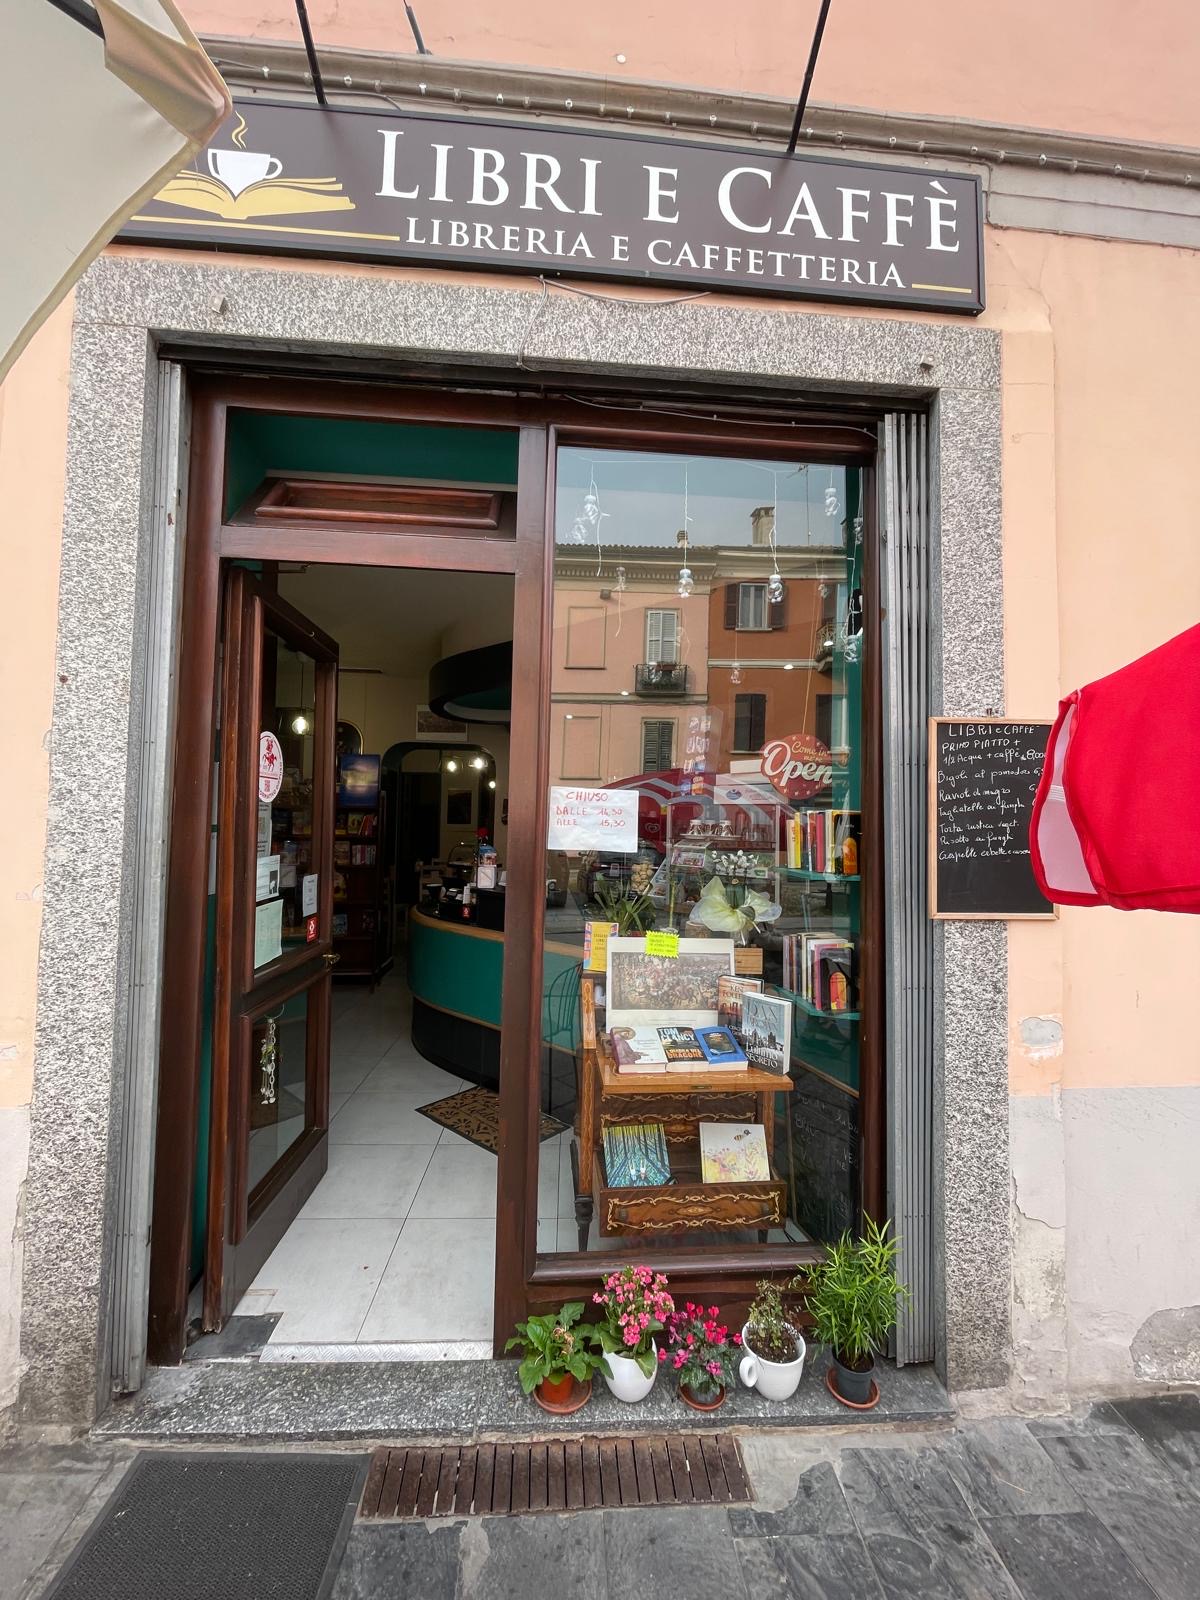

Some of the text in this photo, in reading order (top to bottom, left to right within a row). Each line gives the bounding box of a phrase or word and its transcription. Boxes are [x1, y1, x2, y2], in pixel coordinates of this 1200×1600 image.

[375, 129, 960, 253] LIBRI E CAFFÈ
[406, 217, 906, 289] LIBRERIA E CAFFETTERIA
[949, 724, 992, 737] LIBRI
[791, 741, 818, 755] Come
[974, 739, 1010, 749] PIATTO
[763, 741, 835, 787] Open
[566, 791, 609, 802] CHIUSO
[556, 805, 588, 816] DALLE
[556, 818, 578, 826] ALLE
